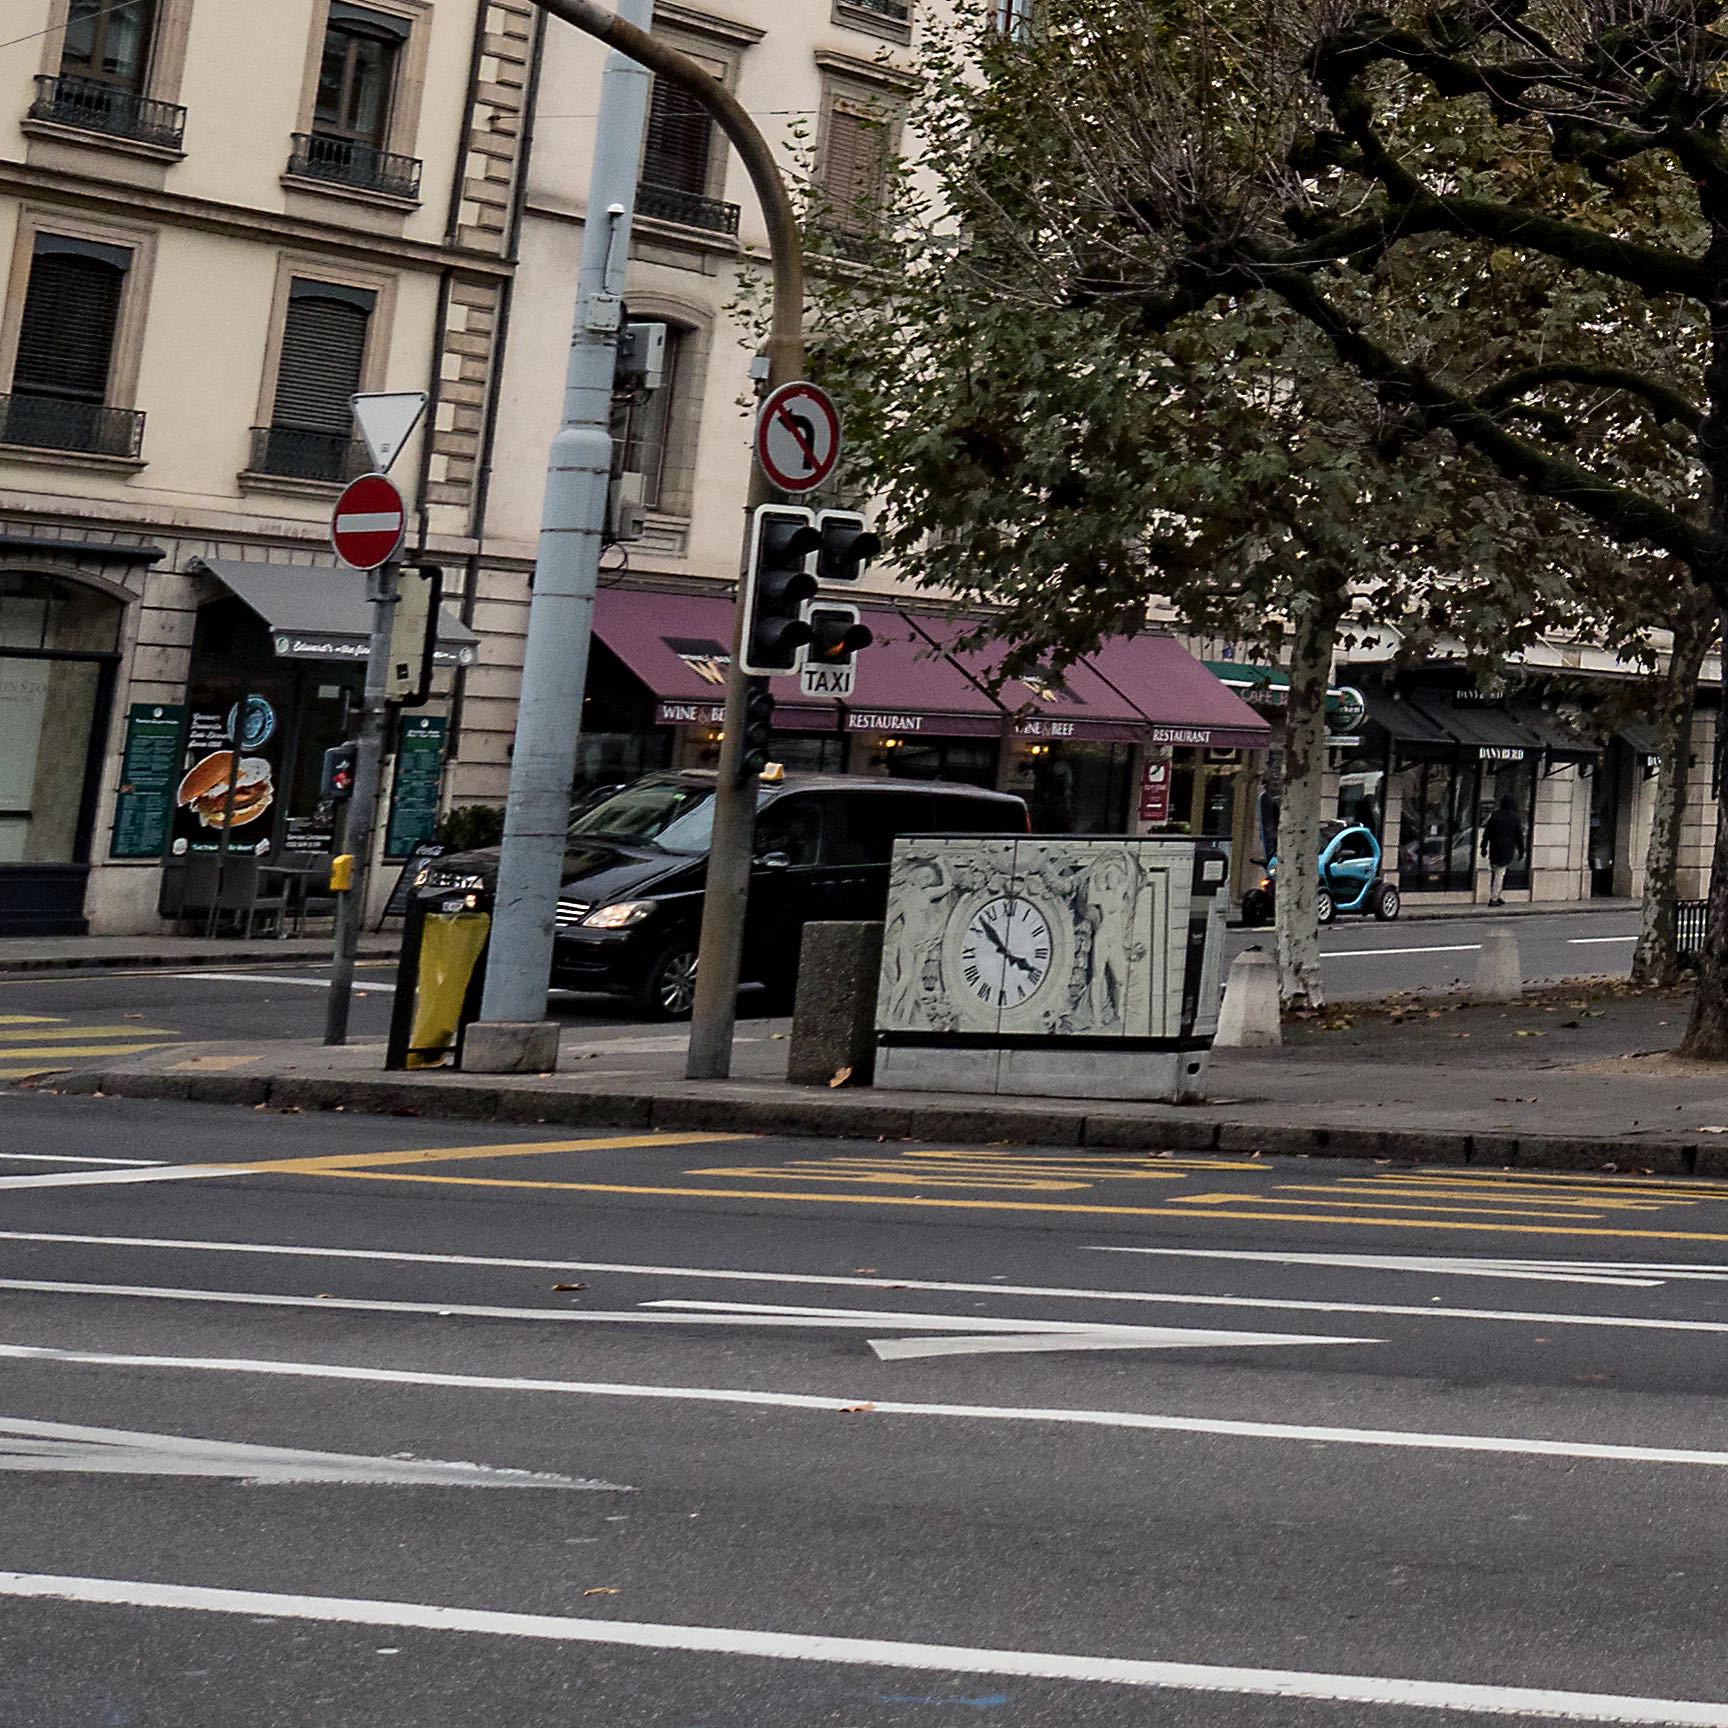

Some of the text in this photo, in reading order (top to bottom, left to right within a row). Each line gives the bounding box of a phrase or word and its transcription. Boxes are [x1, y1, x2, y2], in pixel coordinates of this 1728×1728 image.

[805, 671, 850, 693] TAXI
[663, 705, 696, 722] WINE
[849, 714, 923, 730] RESTAURANT
[1052, 723, 1075, 736] BEEF
[1153, 729, 1211, 744] RESTAURANT
